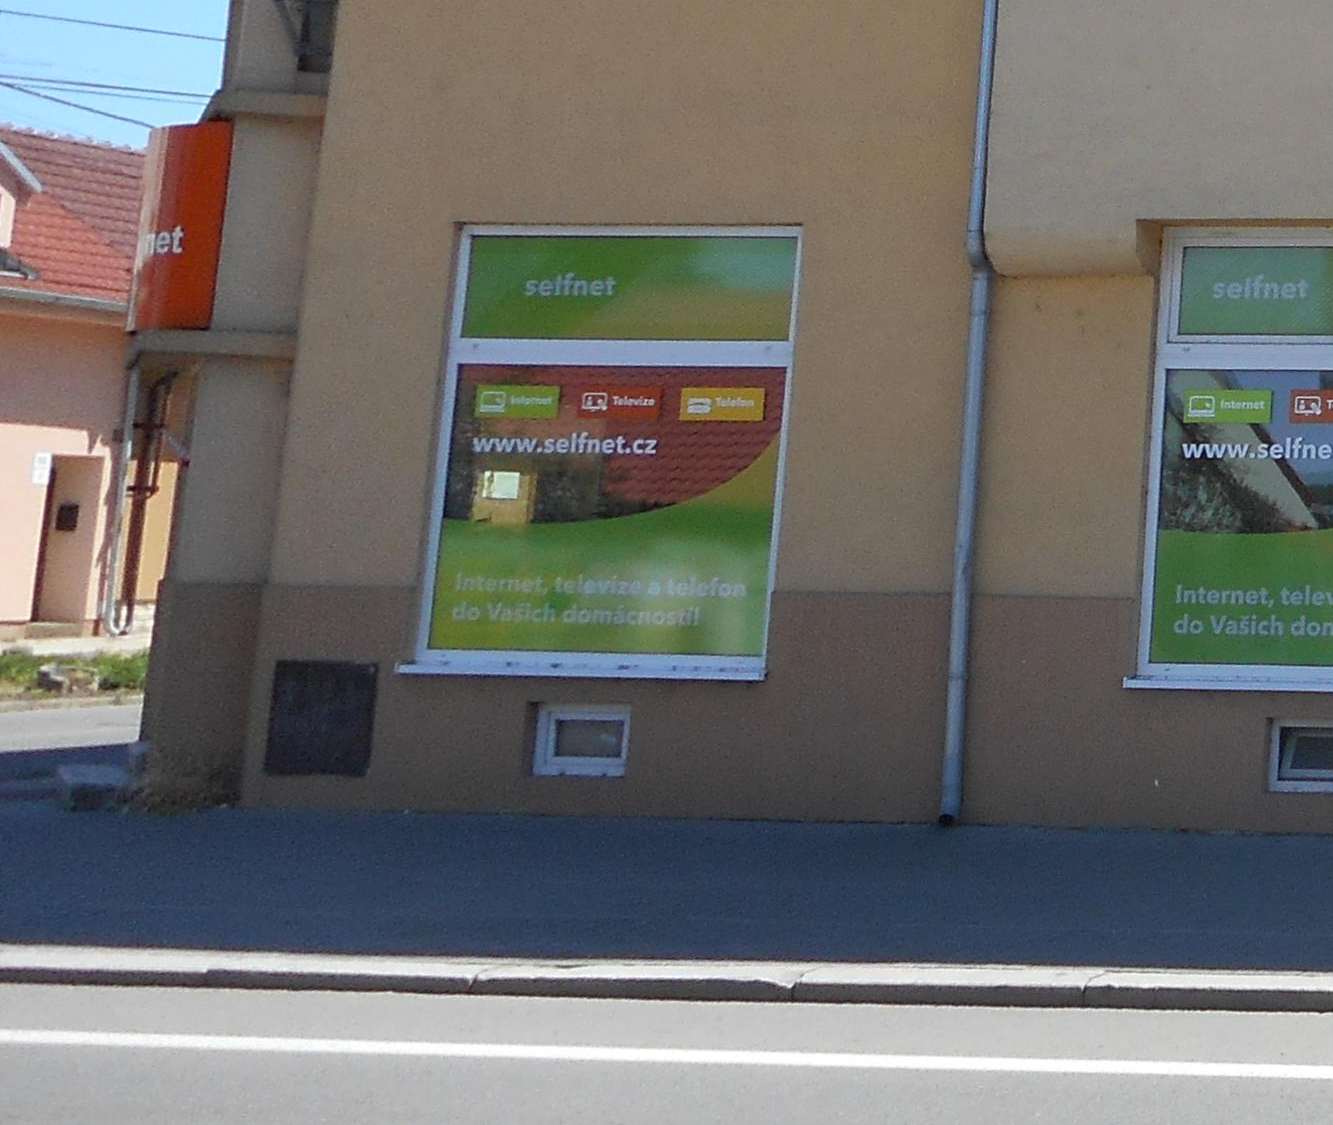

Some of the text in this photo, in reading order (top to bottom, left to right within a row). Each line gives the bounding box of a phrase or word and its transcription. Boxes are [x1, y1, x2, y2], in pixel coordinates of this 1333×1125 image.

[524, 272, 617, 297] selfnet
[1212, 274, 1309, 300] selfnet
[612, 395, 656, 407] Televize
[1220, 397, 1265, 411] Internet
[472, 431, 658, 456] www.selfnet.cz
[555, 575, 642, 596] televize
[647, 580, 661, 595] a
[667, 577, 746, 598] telefon
[1175, 585, 1274, 608] Internet,
[452, 602, 481, 622] do
[488, 602, 556, 623] Vašich
[1174, 613, 1204, 635] do
[1210, 615, 1284, 636] Vašich
